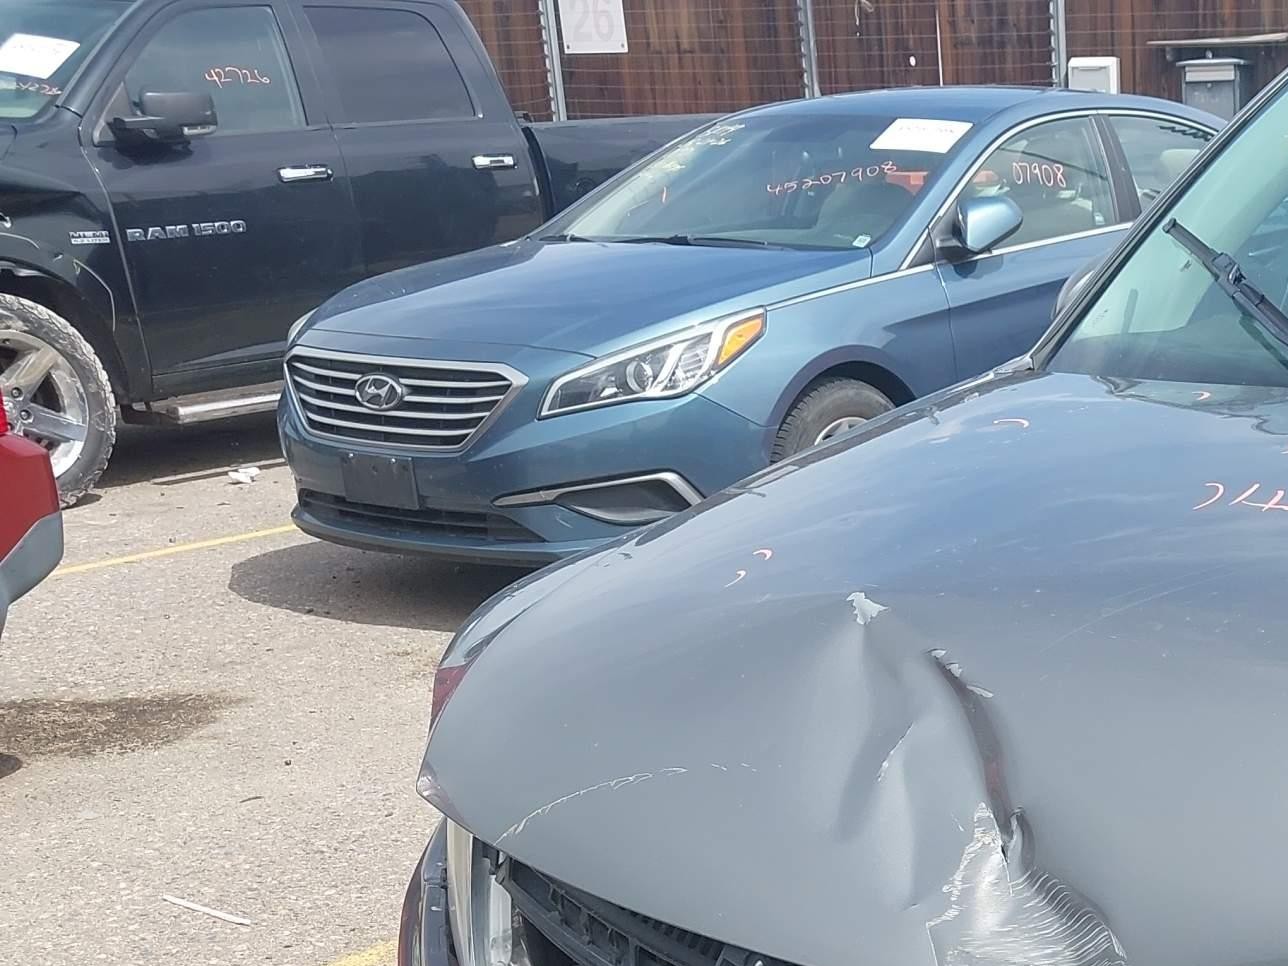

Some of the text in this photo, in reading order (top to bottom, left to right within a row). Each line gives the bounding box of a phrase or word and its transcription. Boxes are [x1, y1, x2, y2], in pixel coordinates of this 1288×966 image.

[204, 66, 271, 88] 42726
[766, 160, 897, 195] 45207908
[1012, 162, 1067, 188] 07908
[126, 219, 247, 242] RAM 1500
